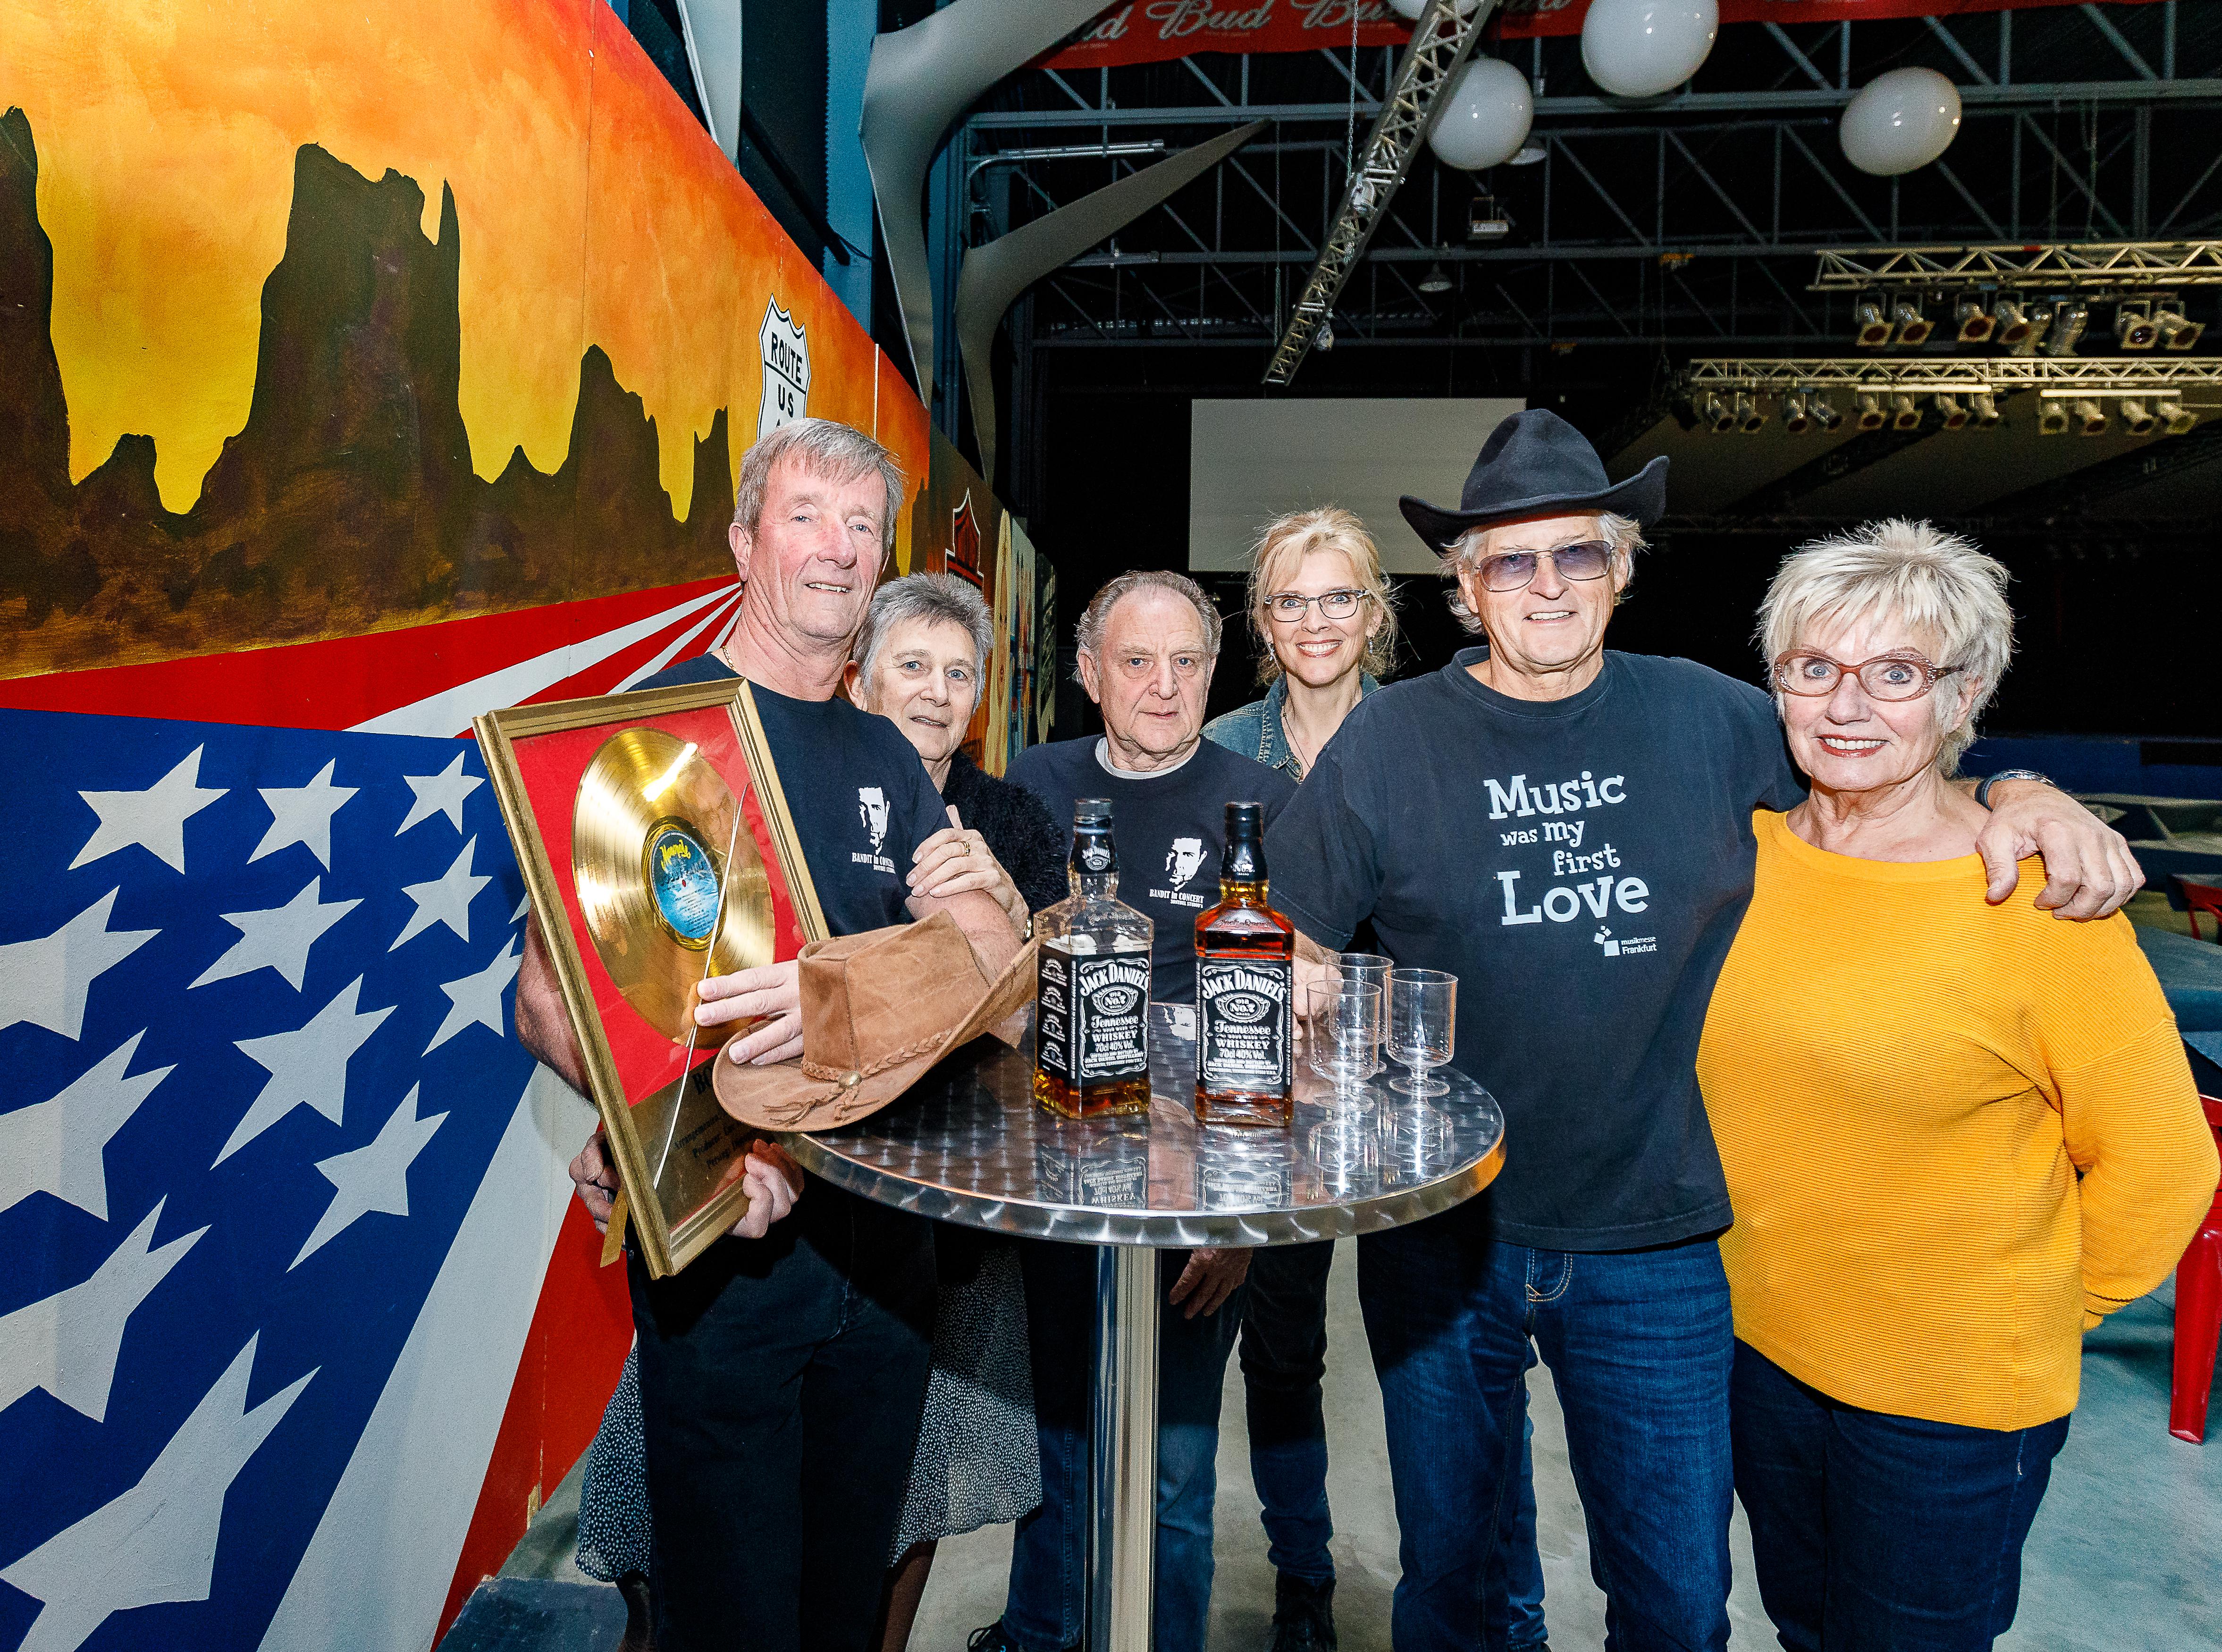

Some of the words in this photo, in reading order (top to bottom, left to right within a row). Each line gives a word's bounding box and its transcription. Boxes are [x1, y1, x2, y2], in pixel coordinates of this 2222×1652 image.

[1145, 0, 1275, 40] Bud
[771, 332, 802, 385] ROUTE
[778, 384, 793, 418] US
[1483, 771, 1627, 819] Music
[1500, 828, 1538, 846] was
[1542, 820, 1585, 847] my
[852, 852, 873, 864] BANDIT
[1553, 843, 1621, 876] first
[1149, 889, 1171, 899] BANDIT
[1178, 892, 1204, 903] CONCERT
[1621, 936, 1656, 945] musikmesse
[1622, 944, 1658, 954] Frankfurt
[1078, 969, 1110, 996] JACK
[1108, 963, 1150, 991] DANIEL'S
[1201, 974, 1236, 999] JACK
[1234, 969, 1287, 1002] DANIEL'S
[1091, 1015, 1139, 1028] Tennessee
[1214, 1020, 1271, 1035] Tennessee
[1092, 1029, 1138, 1043] WHISKEY
[1095, 1042, 1109, 1053] 70cl
[1109, 1041, 1123, 1051] 40%
[1215, 1038, 1270, 1049] WHISKEY
[1253, 1050, 1266, 1060] Vol.
